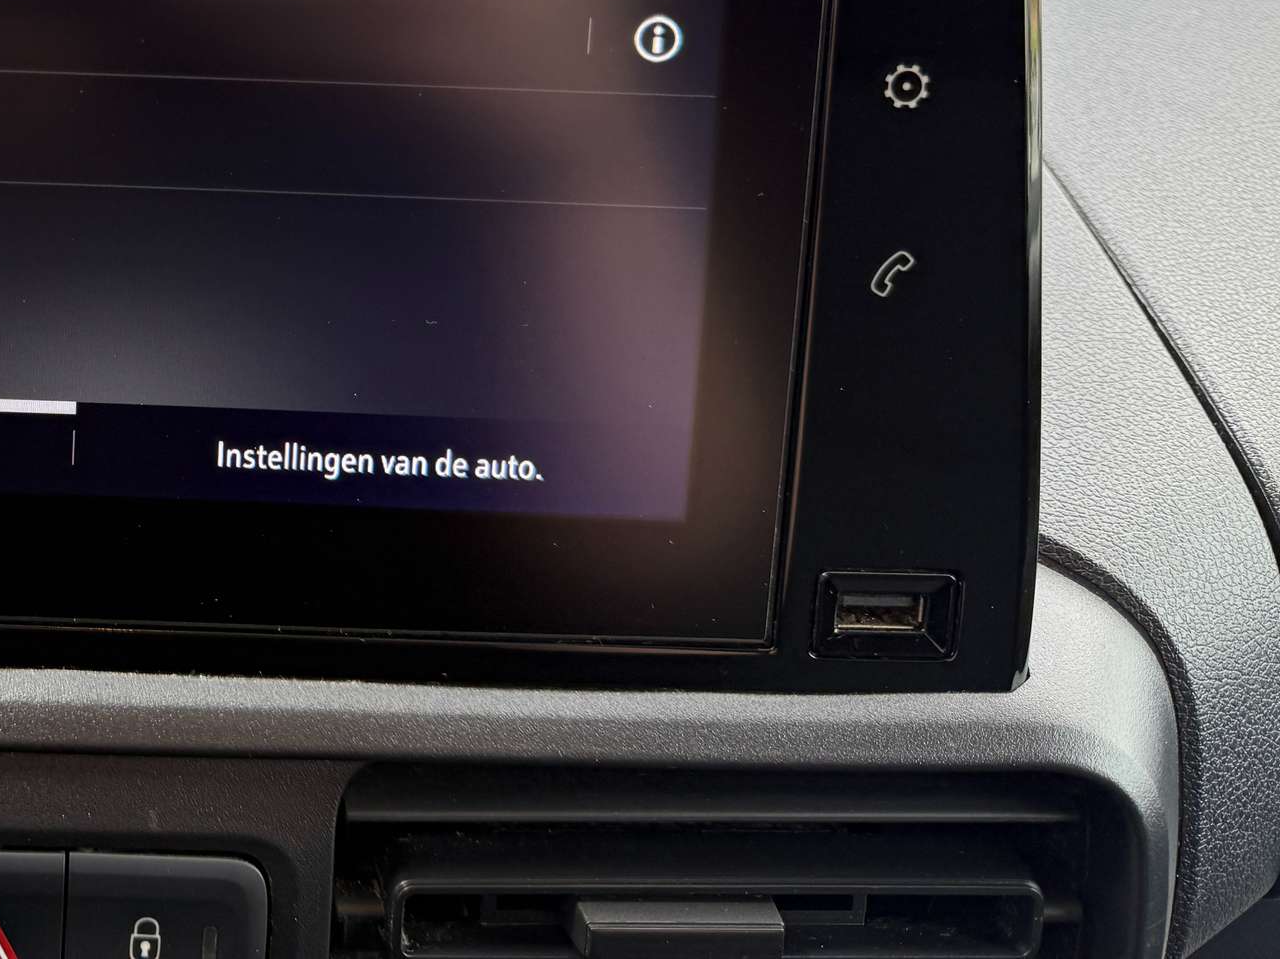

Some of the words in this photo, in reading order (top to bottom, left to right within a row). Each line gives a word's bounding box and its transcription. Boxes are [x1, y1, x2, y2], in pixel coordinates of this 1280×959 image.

[216, 440, 375, 481] Instellingen
[379, 453, 429, 477] van
[433, 447, 469, 479] de
[473, 454, 545, 482] auto.
